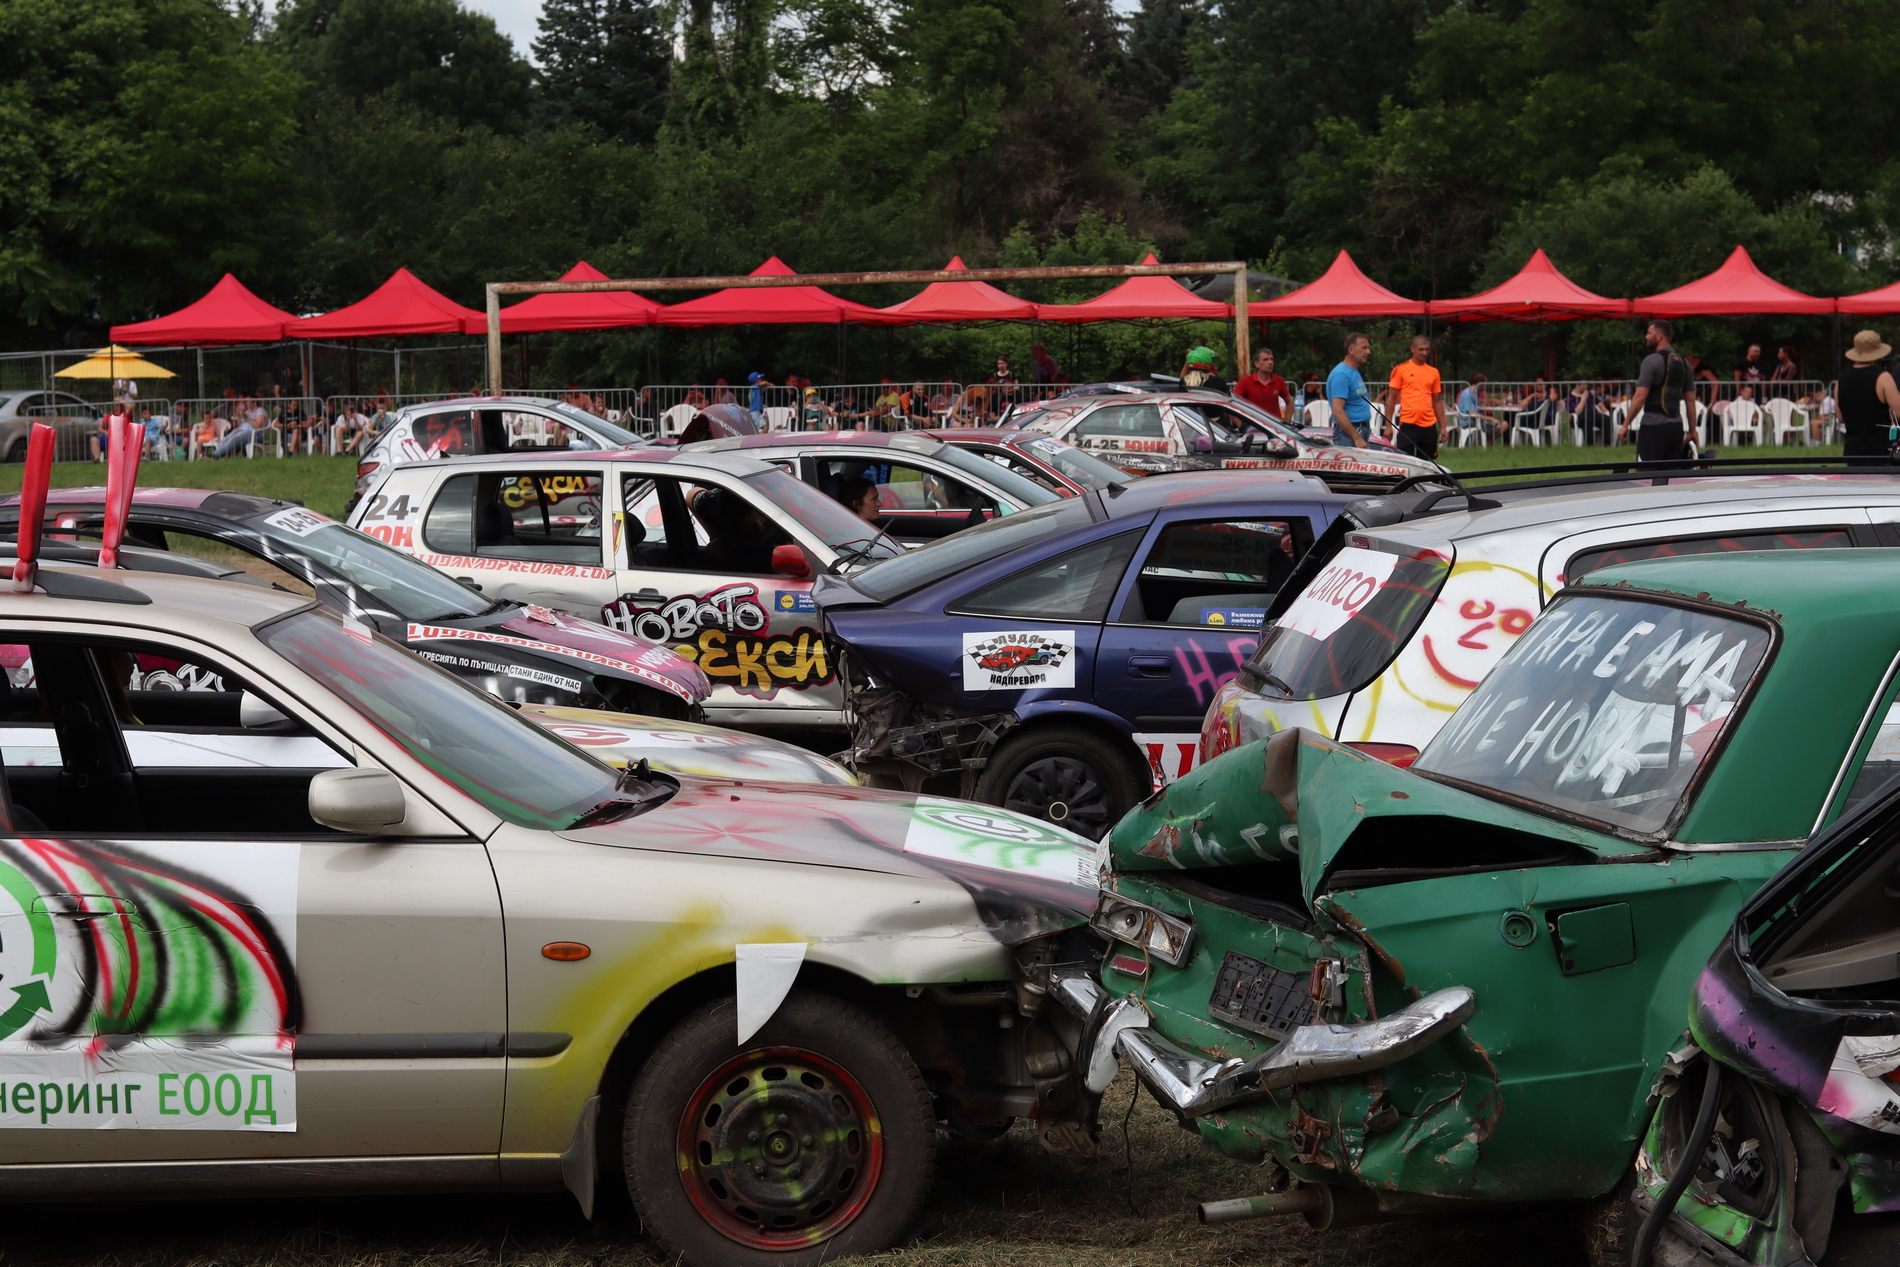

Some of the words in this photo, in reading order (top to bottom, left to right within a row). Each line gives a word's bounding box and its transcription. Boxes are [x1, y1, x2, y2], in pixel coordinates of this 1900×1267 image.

[997, 633, 1040, 645] ЛУДА
[459, 657, 470, 667] ПО
[470, 660, 509, 675] ПЪТИЩАТА
[509, 665, 533, 678] СТАНИ
[533, 671, 554, 683] ЕДИН
[554, 676, 564, 686] ОТ
[564, 680, 581, 690] НАС
[989, 673, 1047, 687] НАДПРЕВАРА
[0, 1081, 141, 1125] еринг
[158, 1072, 277, 1126] ЕООД
